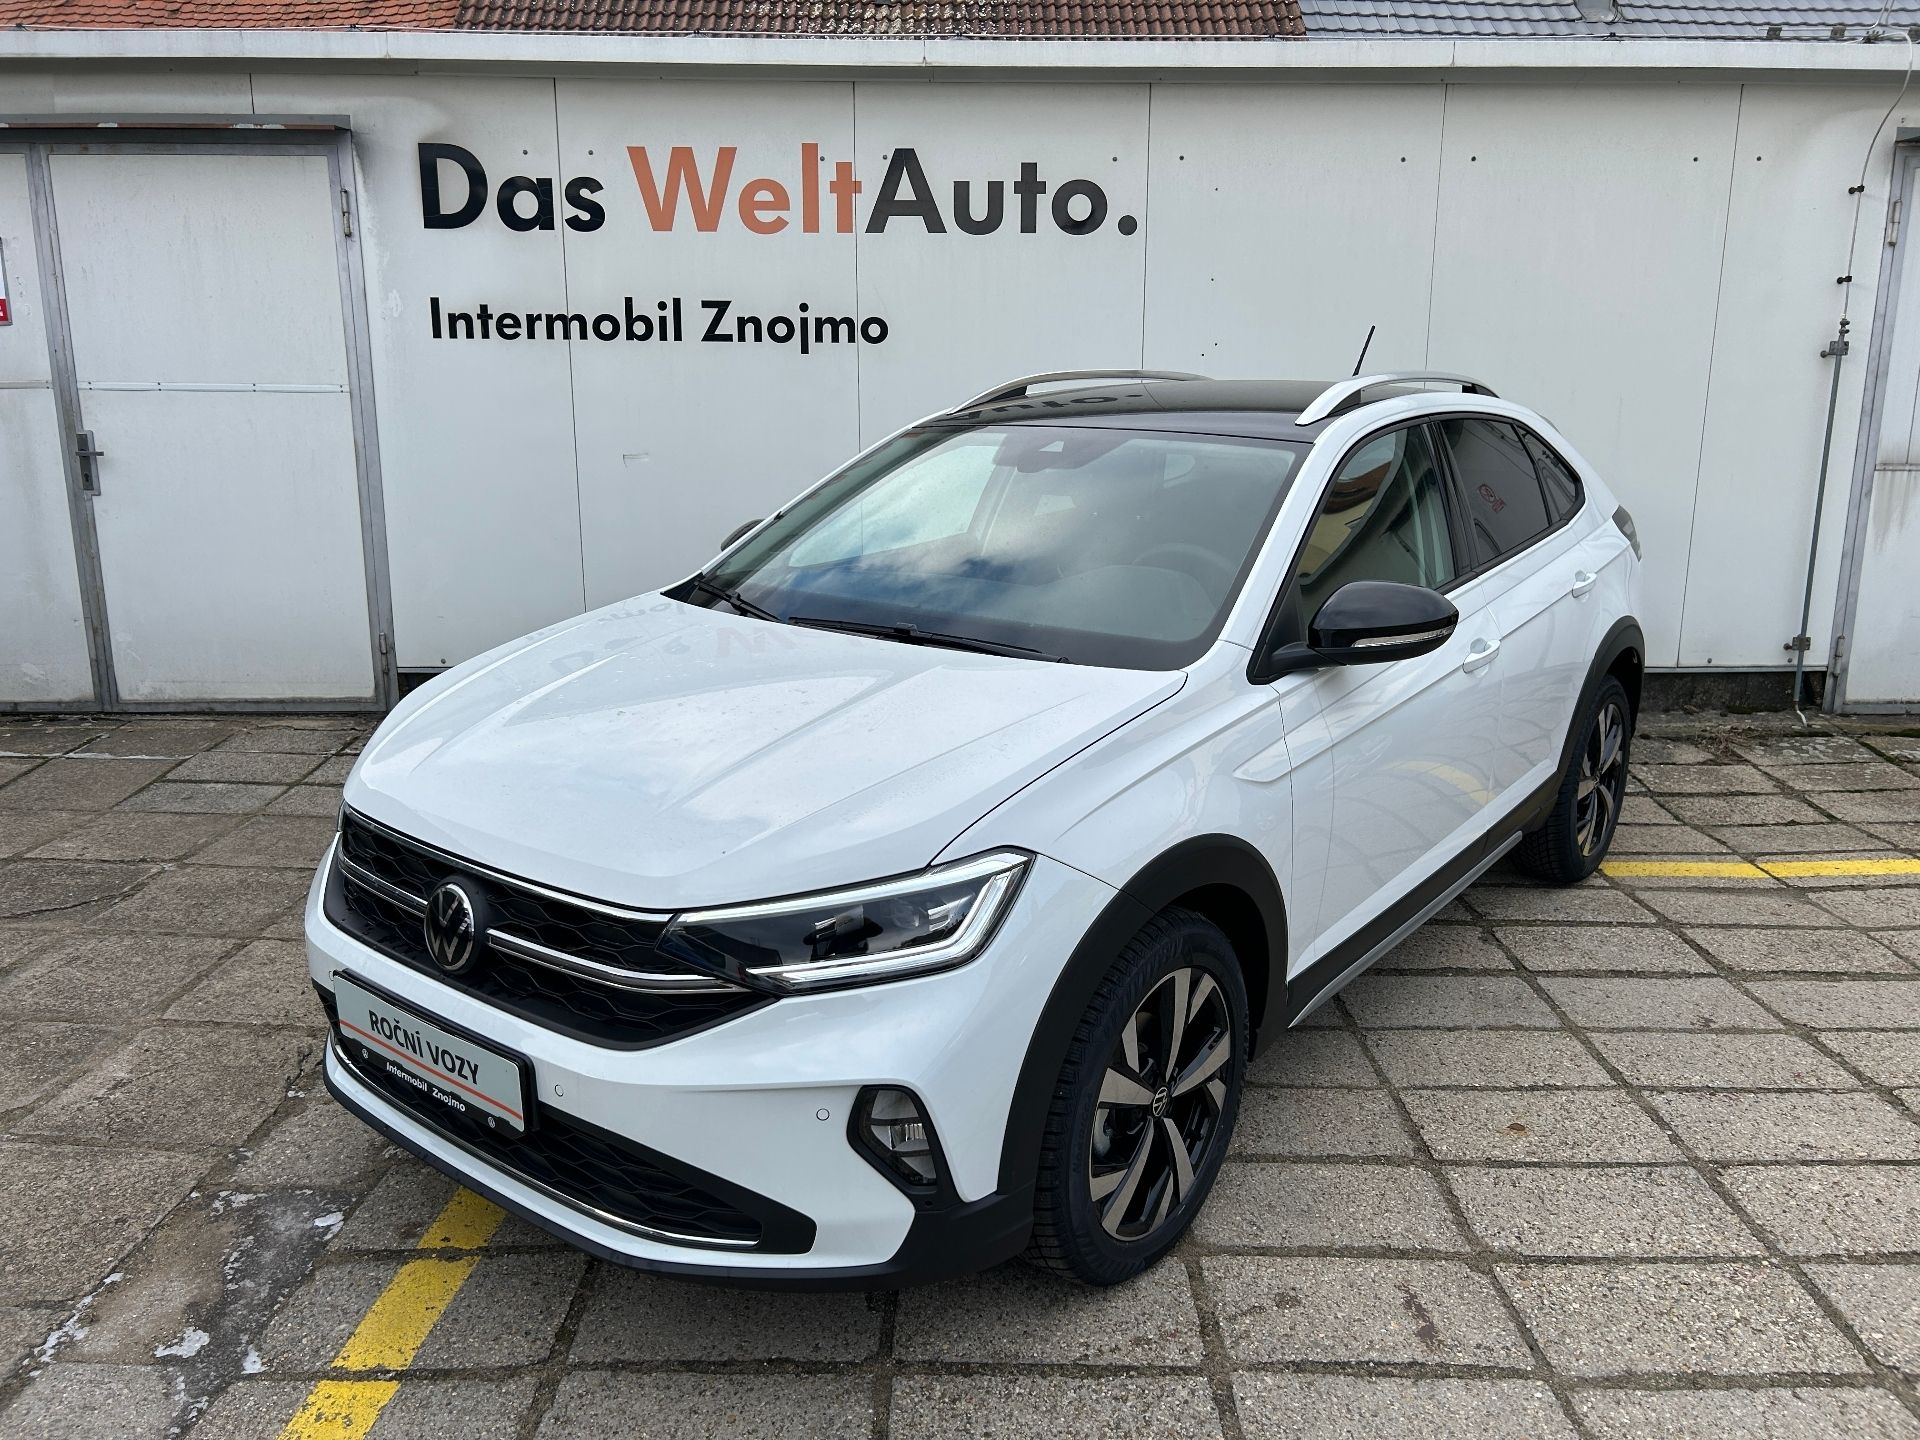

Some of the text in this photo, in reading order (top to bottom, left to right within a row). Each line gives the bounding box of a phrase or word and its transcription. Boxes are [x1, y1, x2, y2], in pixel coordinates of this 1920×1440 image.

[417, 143, 1138, 236] Das WeltAuto.
[430, 297, 889, 354] Intermobil Znojmo
[368, 1009, 480, 1086] ROČNÍ VOZY
[386, 1061, 466, 1112] Intermobil Znojmo
